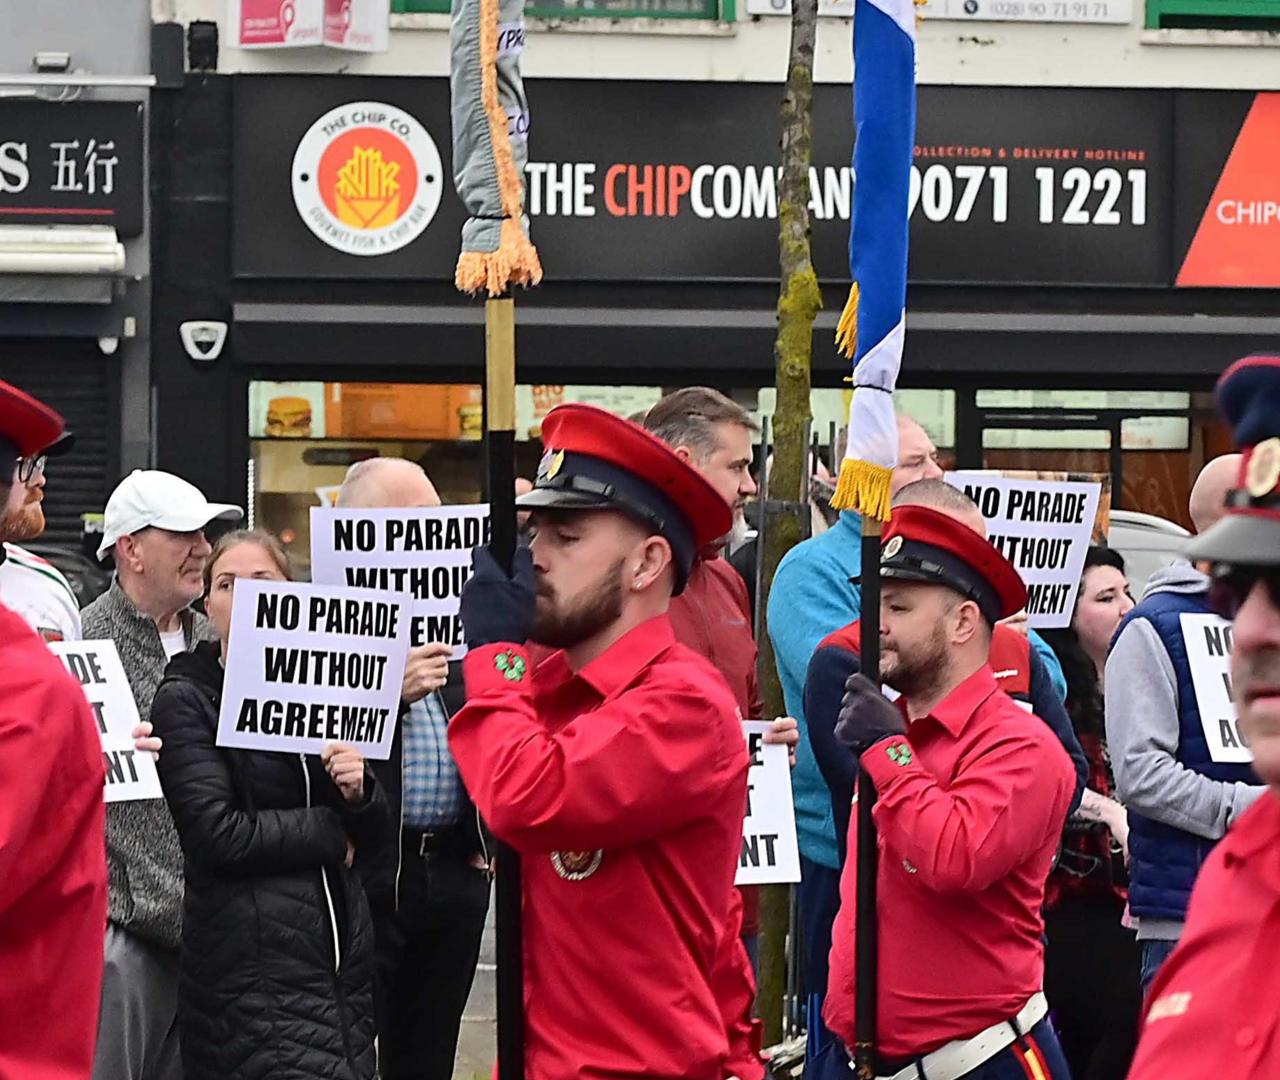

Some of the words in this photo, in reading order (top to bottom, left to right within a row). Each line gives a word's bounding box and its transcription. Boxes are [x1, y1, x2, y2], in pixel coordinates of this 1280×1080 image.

[321, 115, 348, 137] THE
[351, 111, 387, 124] CHIP
[50, 138, 119, 195] 五行
[912, 145, 992, 158] OLLECTION
[1013, 147, 1079, 160] DELIVERY
[1085, 149, 1147, 161] HOTLINE
[524, 163, 596, 216] THE
[1035, 167, 1147, 226] 1221
[1006, 489, 1088, 524] PARADE
[334, 519, 376, 552] NO
[345, 566, 475, 600] WITHOU
[256, 592, 301, 631] NO
[308, 596, 400, 639] PARADE
[264, 647, 388, 690] WITHOUT
[235, 698, 390, 743] AGREEMENT
